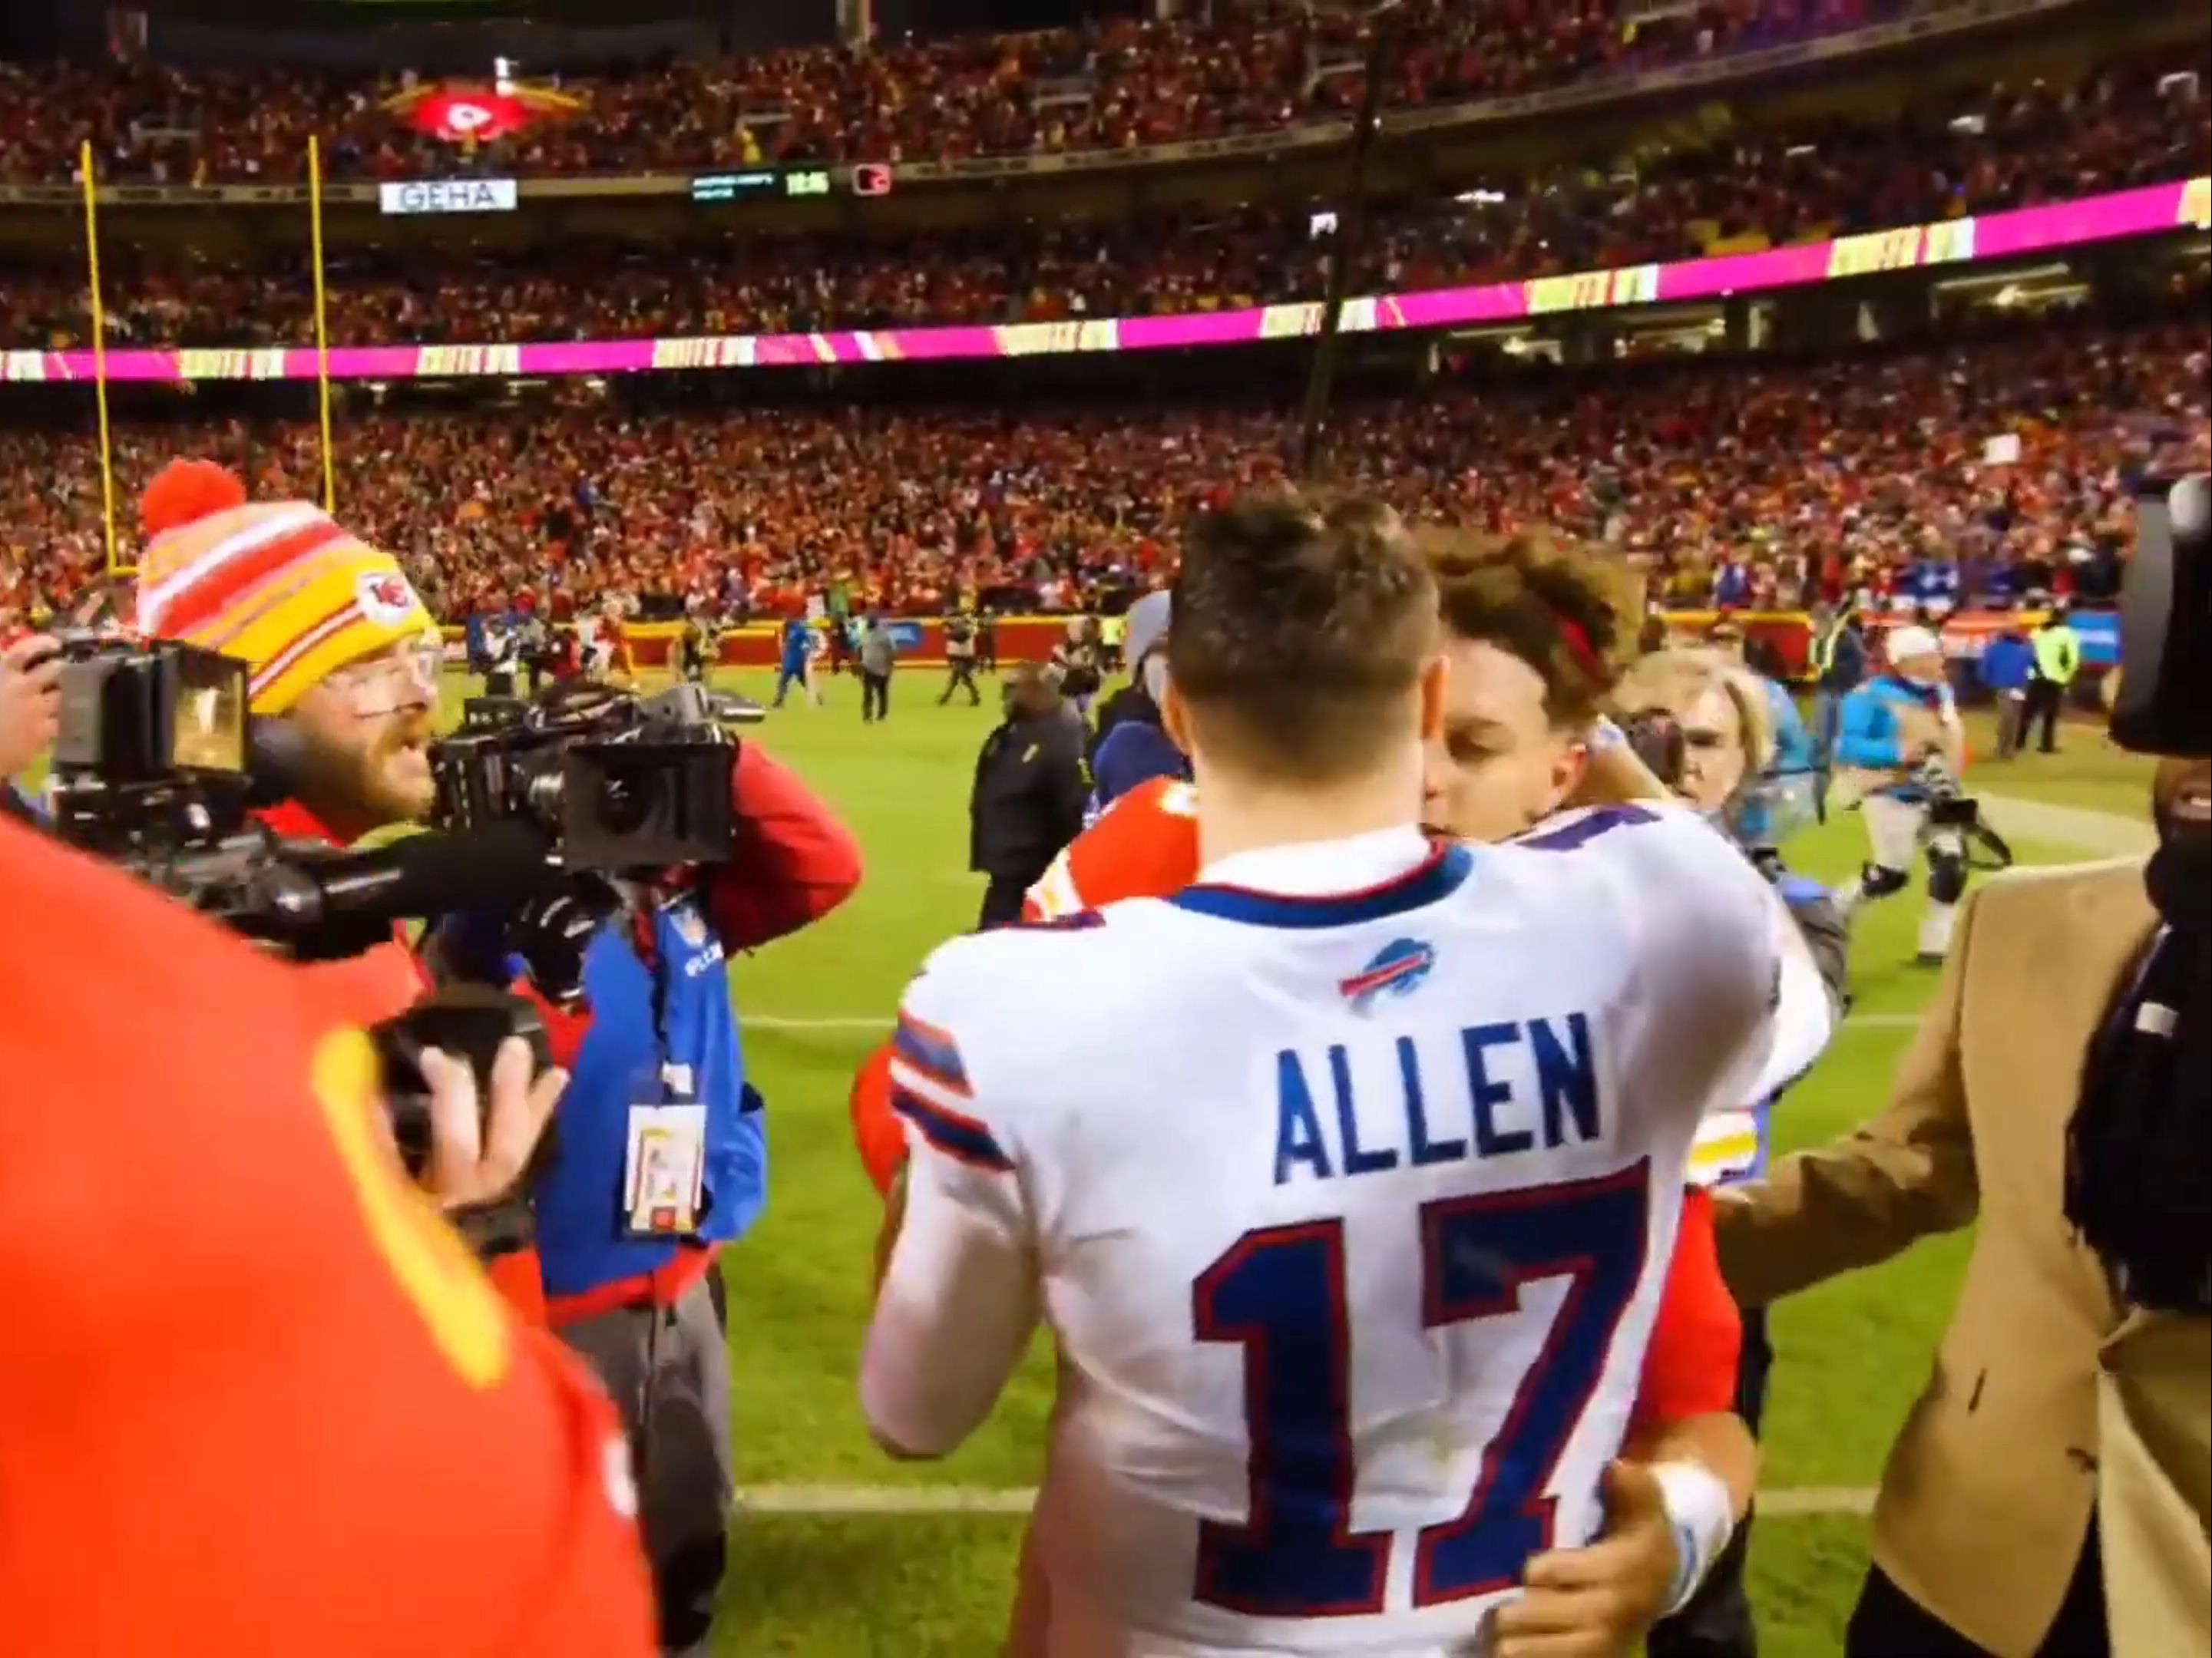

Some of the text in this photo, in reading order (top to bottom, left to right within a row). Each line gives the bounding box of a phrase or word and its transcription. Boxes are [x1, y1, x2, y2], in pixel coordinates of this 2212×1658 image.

[401, 183, 495, 213] GEHA
[1274, 1012, 1601, 1184] ALLEN
[1192, 1155, 1650, 1619] 17
